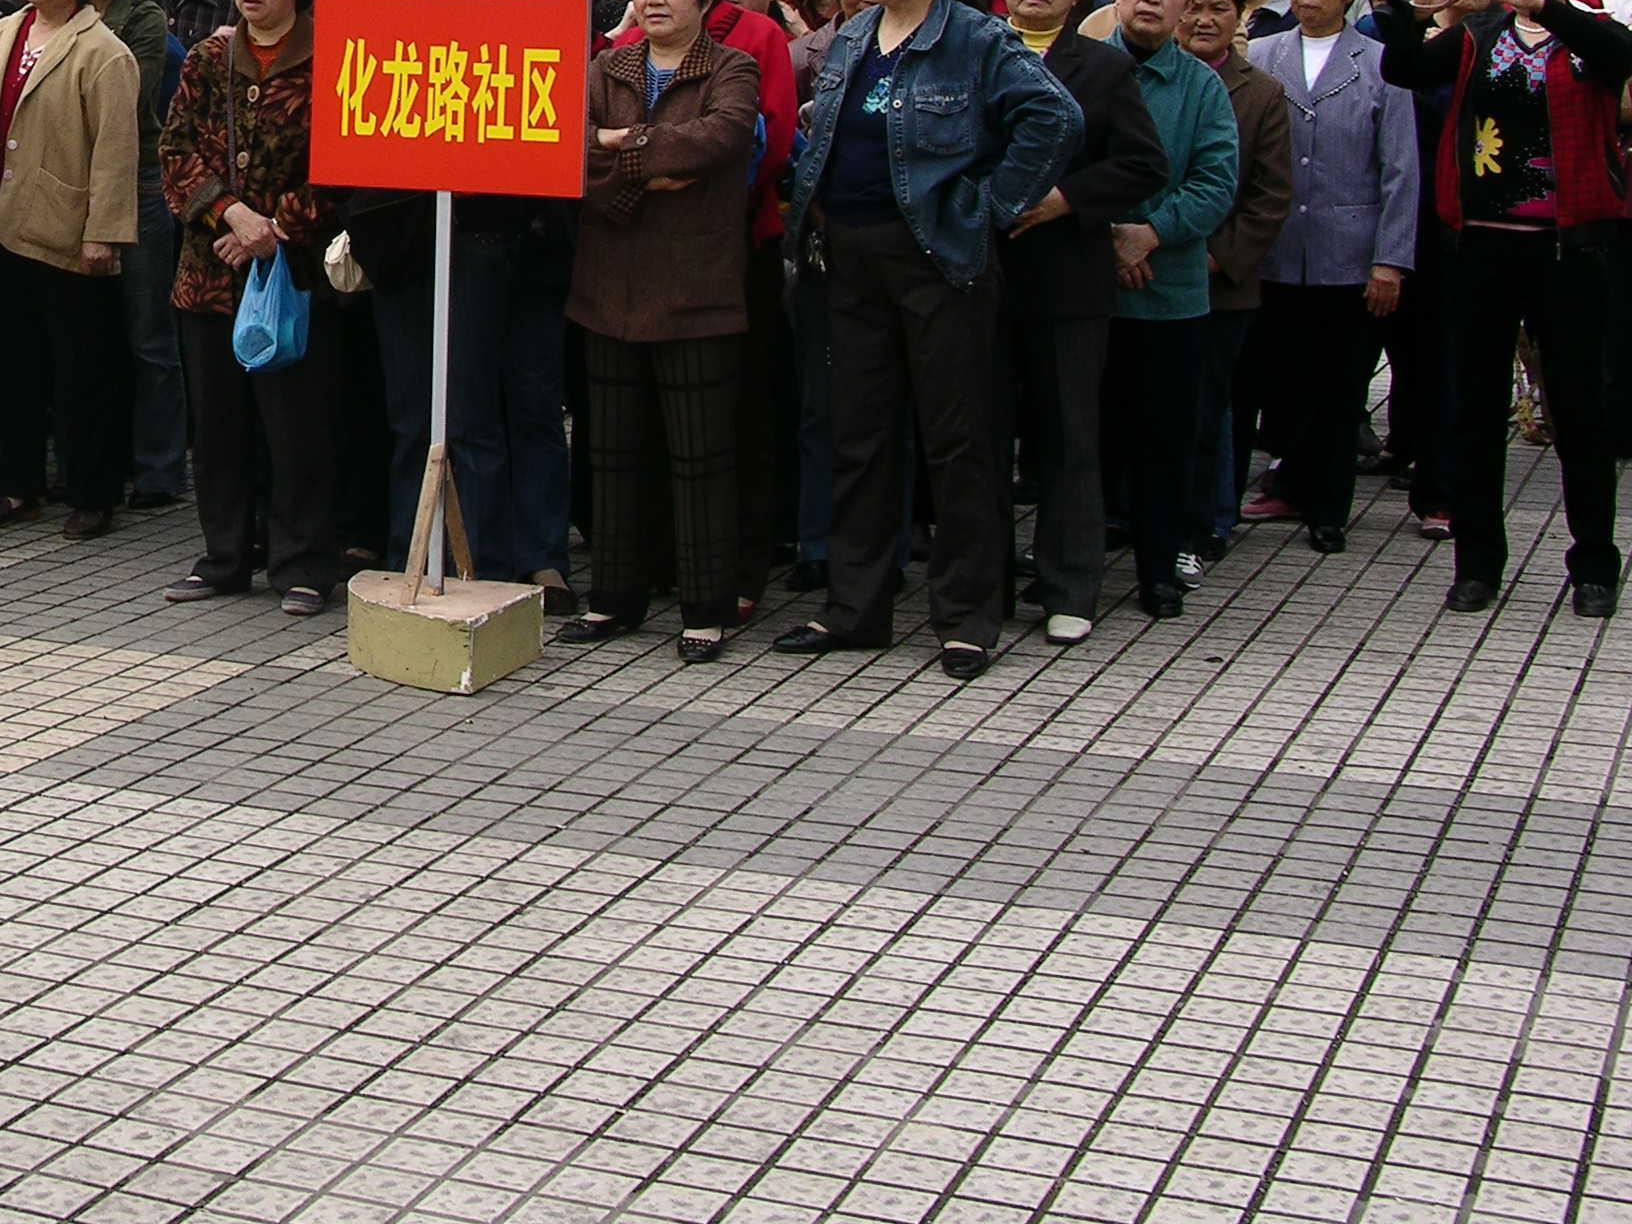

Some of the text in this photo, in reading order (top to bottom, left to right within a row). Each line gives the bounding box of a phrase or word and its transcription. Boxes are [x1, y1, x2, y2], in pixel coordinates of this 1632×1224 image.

[336, 38, 561, 144] 化龙路社区
